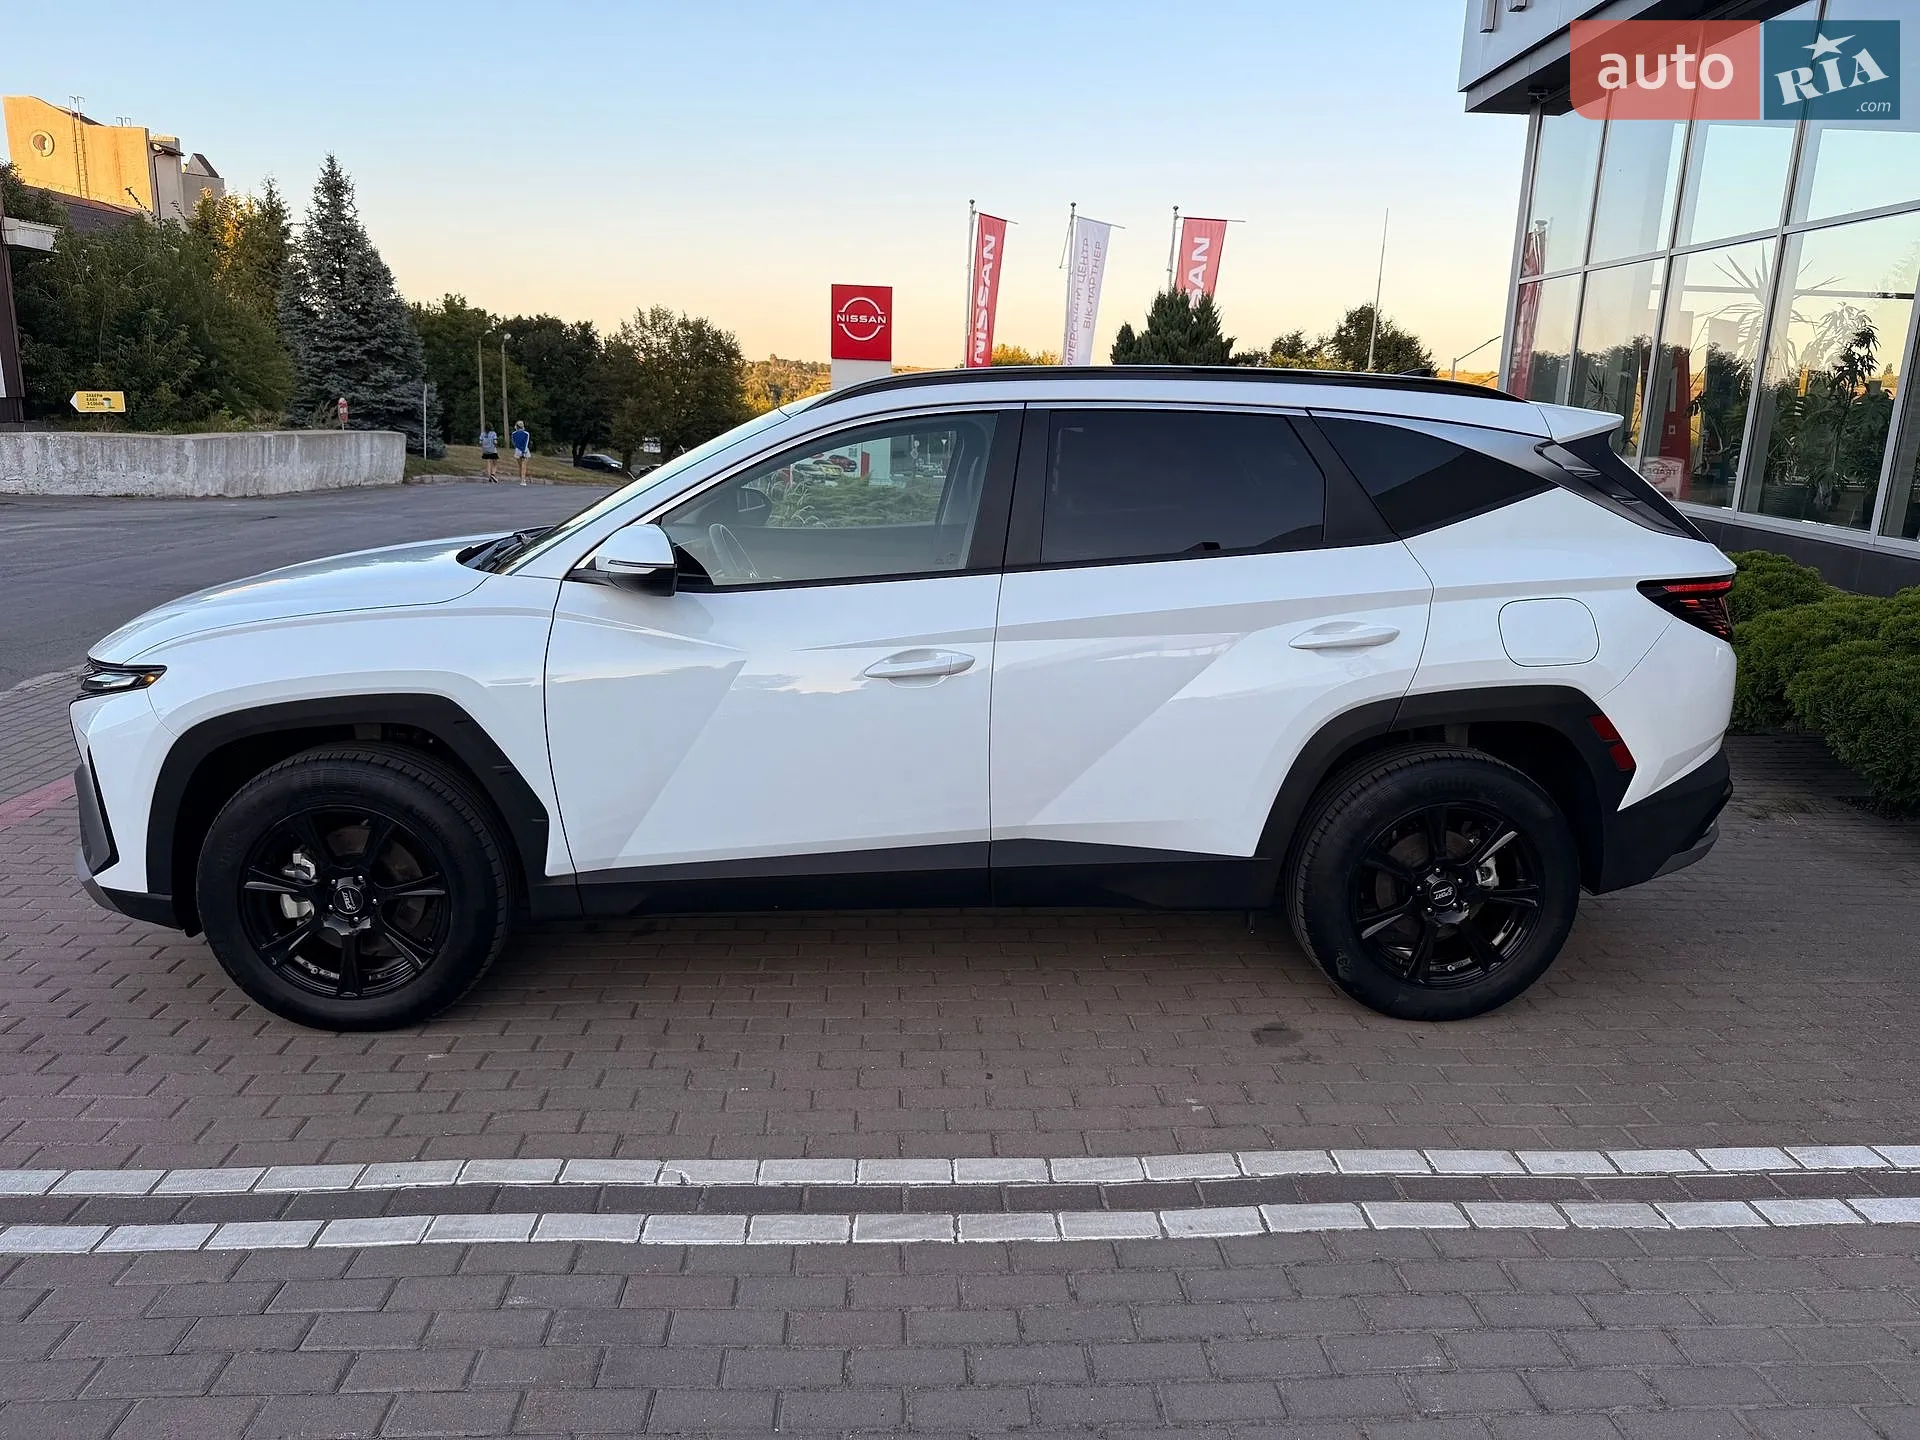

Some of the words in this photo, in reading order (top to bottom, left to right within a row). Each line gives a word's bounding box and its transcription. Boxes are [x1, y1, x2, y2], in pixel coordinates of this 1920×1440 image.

[1077, 238, 1089, 283] ЦЕНТР
[836, 313, 887, 324] NISSAN
[973, 234, 996, 364] NISSAN
